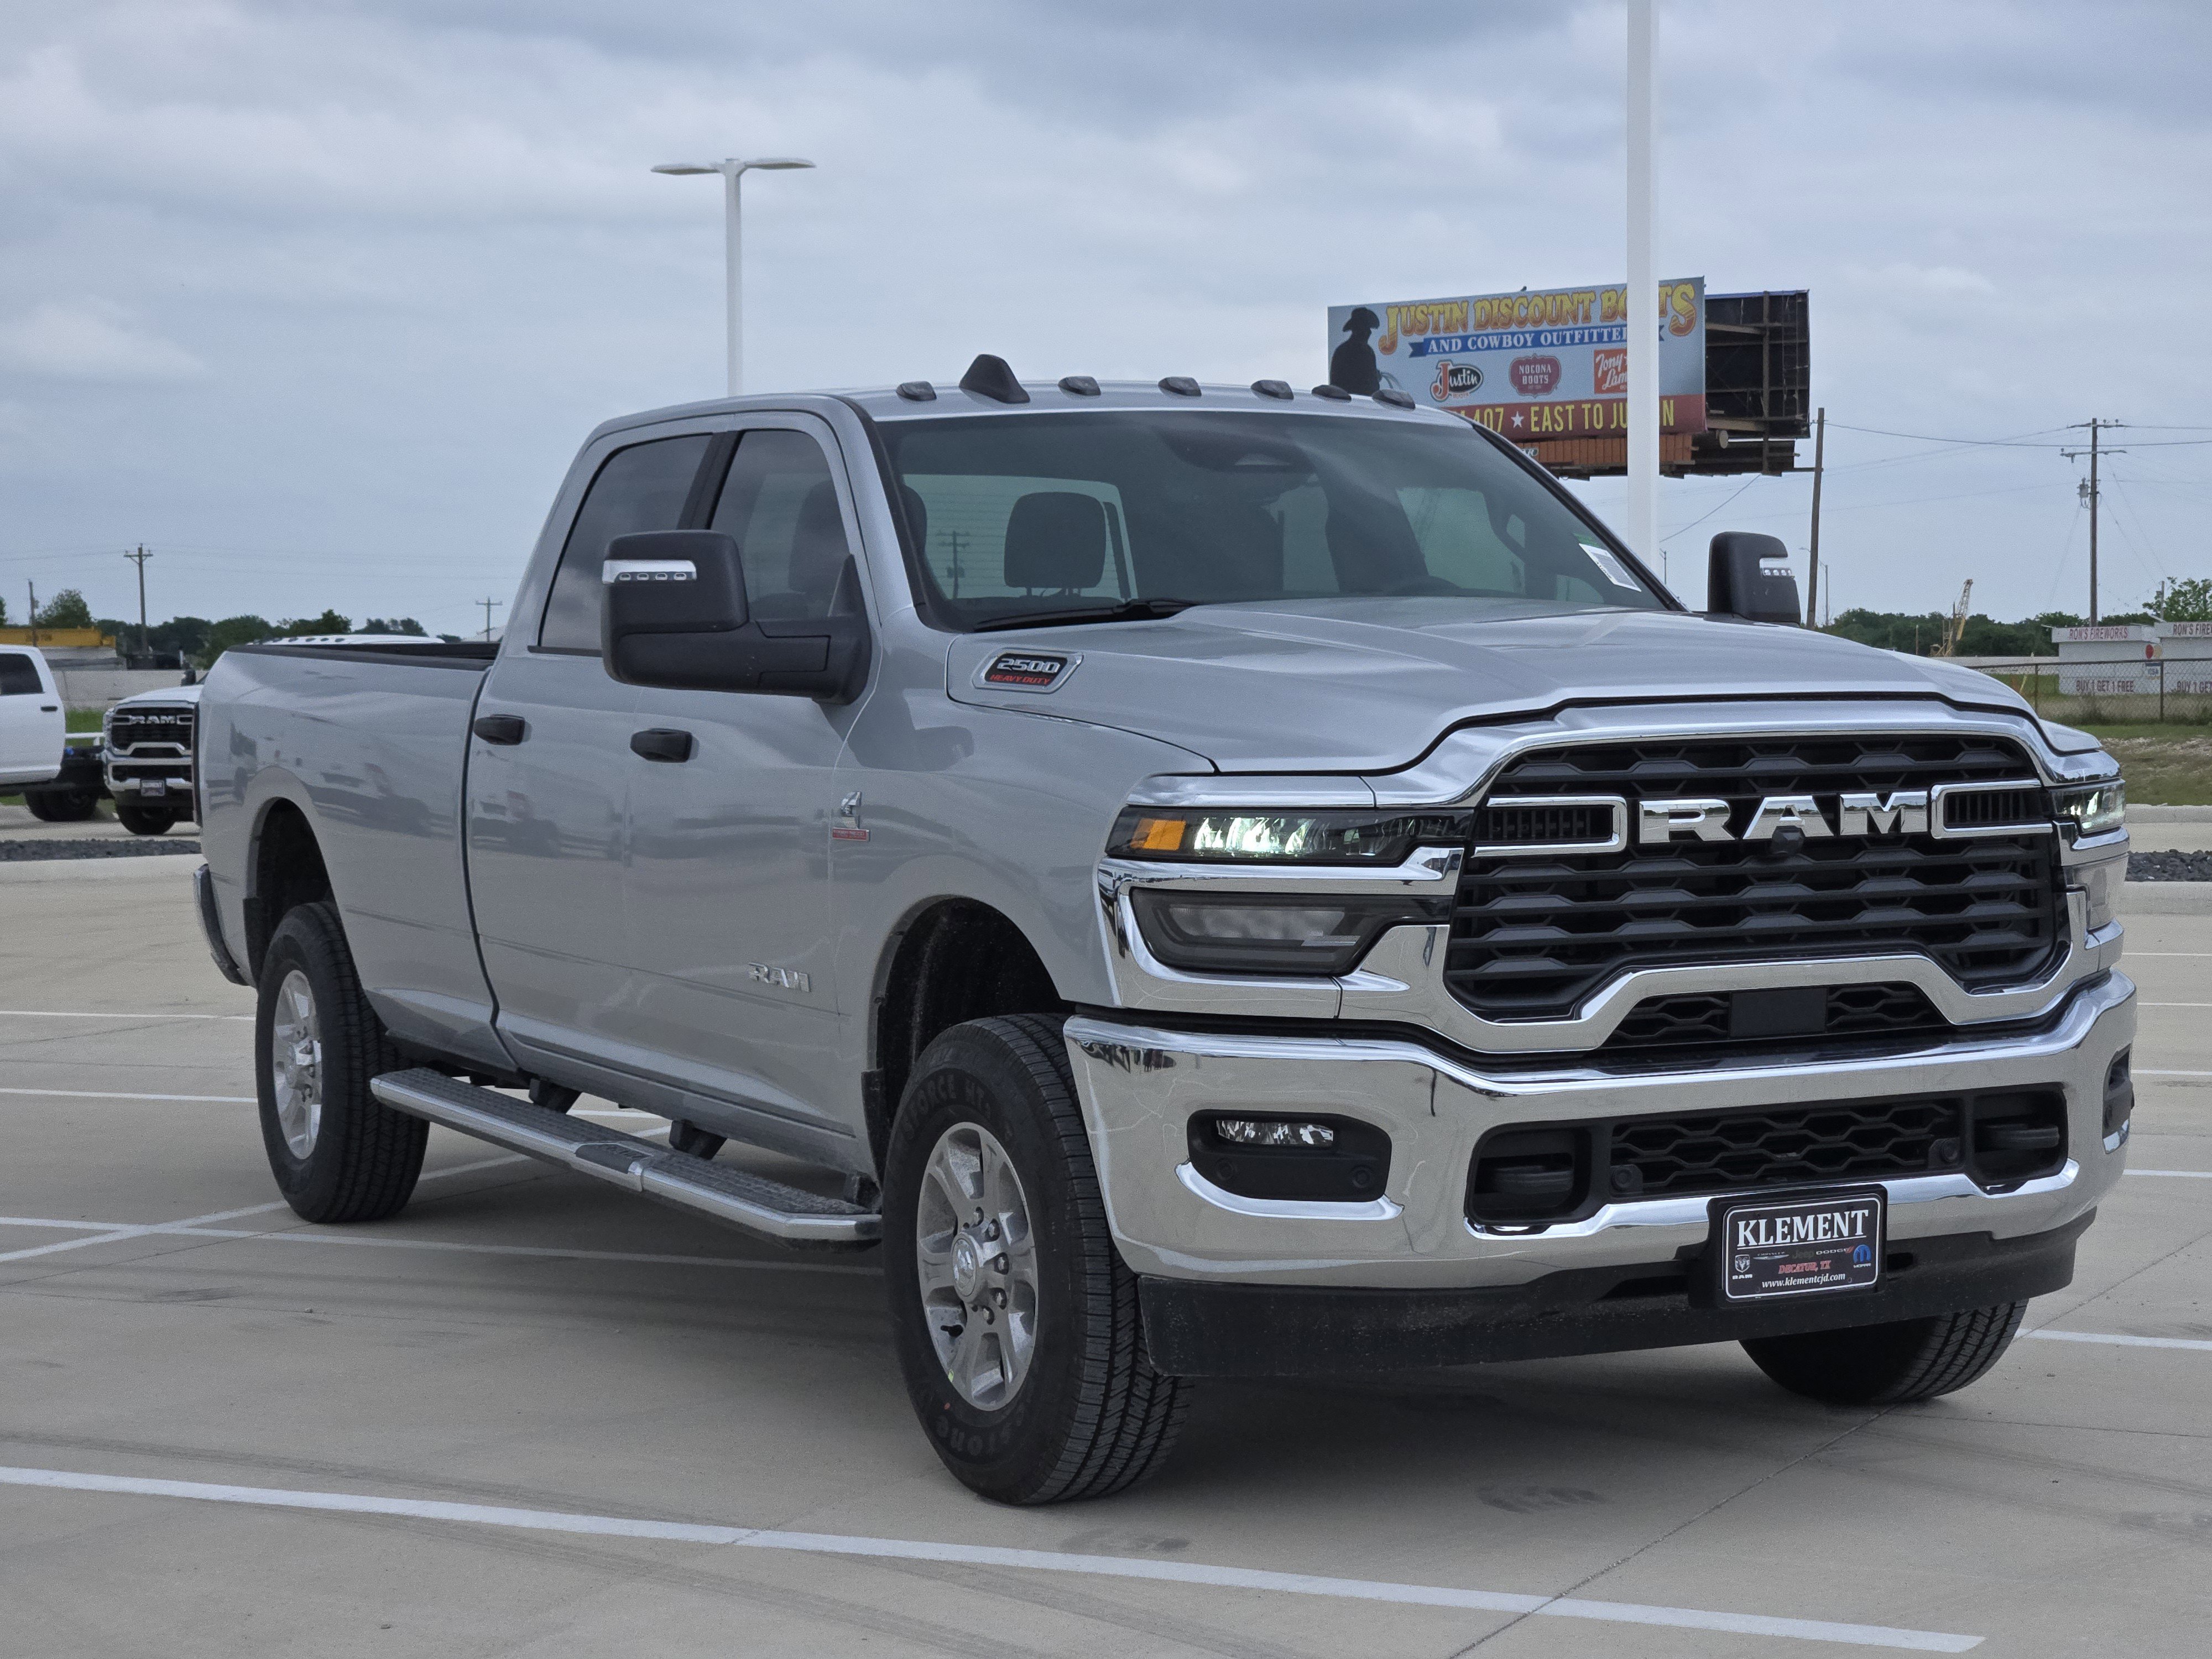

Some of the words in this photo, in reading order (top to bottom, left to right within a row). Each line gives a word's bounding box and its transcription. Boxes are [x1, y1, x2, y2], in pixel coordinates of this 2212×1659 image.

[1378, 300, 1468, 355] JUSTIN
[1474, 290, 1596, 330] DISCOUNT
[1600, 284, 1697, 336] BTS
[1428, 338, 1462, 352] AND
[1467, 333, 1535, 350] COWBOY
[1540, 326, 1627, 345] OUTFITTE
[1519, 364, 1551, 374] NOCONA
[1595, 353, 1623, 378] Tony
[1431, 361, 1479, 401] Justin
[1522, 374, 1549, 384] BOOTS
[1602, 369, 1627, 390] Lam
[1531, 404, 1574, 432] EAST
[1582, 403, 1603, 430] TO
[1610, 399, 1674, 430] JUN
[2090, 627, 2128, 639] FIREWORKS
[2195, 622, 2212, 635] FIRE
[997, 658, 1061, 674] 2500
[990, 674, 1021, 683] HEAVY
[2117, 680, 2133, 692] FREE
[131, 716, 175, 724] RAM
[1639, 791, 1928, 844] RAM
[748, 962, 811, 992] RAM
[1737, 1209, 1869, 1246] KLEMENT
[1820, 1260, 1832, 1270] TX
[1762, 1273, 1846, 1288] www.klementcjd.com
